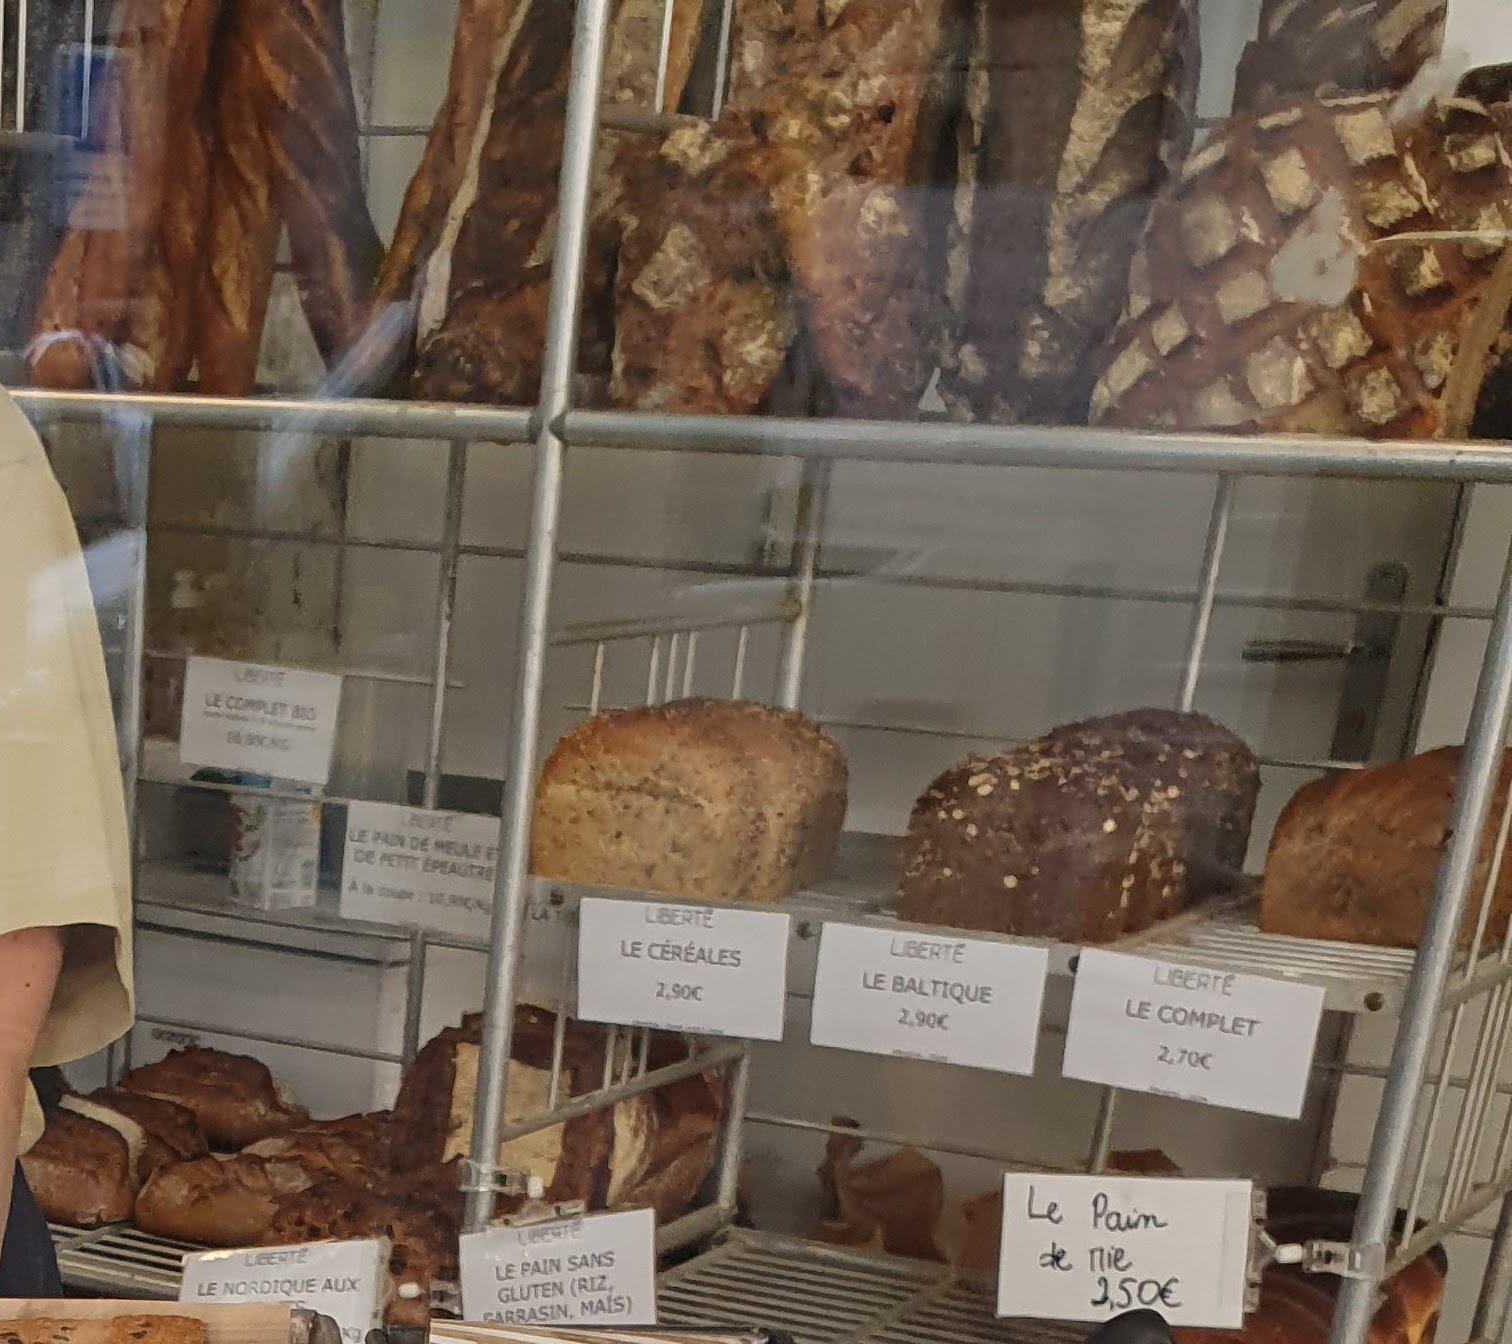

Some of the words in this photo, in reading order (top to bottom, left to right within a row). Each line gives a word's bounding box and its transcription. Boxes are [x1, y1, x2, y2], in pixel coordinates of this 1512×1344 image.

[205, 692, 221, 708] LE
[226, 695, 289, 717] COMPLET
[349, 829, 368, 843] LE
[646, 905, 714, 929] LIBERTÉ
[621, 939, 643, 958] LE
[647, 939, 742, 968] CÉRÉALES
[890, 938, 967, 964] LIBERTÉ
[863, 971, 886, 990] LE
[891, 975, 992, 1005] BALTIQUE
[1153, 965, 1237, 997] LIBERTÉ
[1125, 999, 1151, 1020] LE
[1157, 1004, 1261, 1037] COMPLET
[1027, 1184, 1064, 1225] Le
[1091, 1192, 1169, 1232] Pain
[495, 1264, 516, 1282] LE
[520, 1257, 562, 1278] PAIN
[566, 1250, 616, 1271] SANS
[197, 1280, 217, 1297] LE
[220, 1277, 319, 1298] NORDIQUE
[322, 1277, 361, 1294] AUX
[497, 1280, 564, 1304] GLUTEN
[1090, 1276, 1183, 1311] 2,50€
